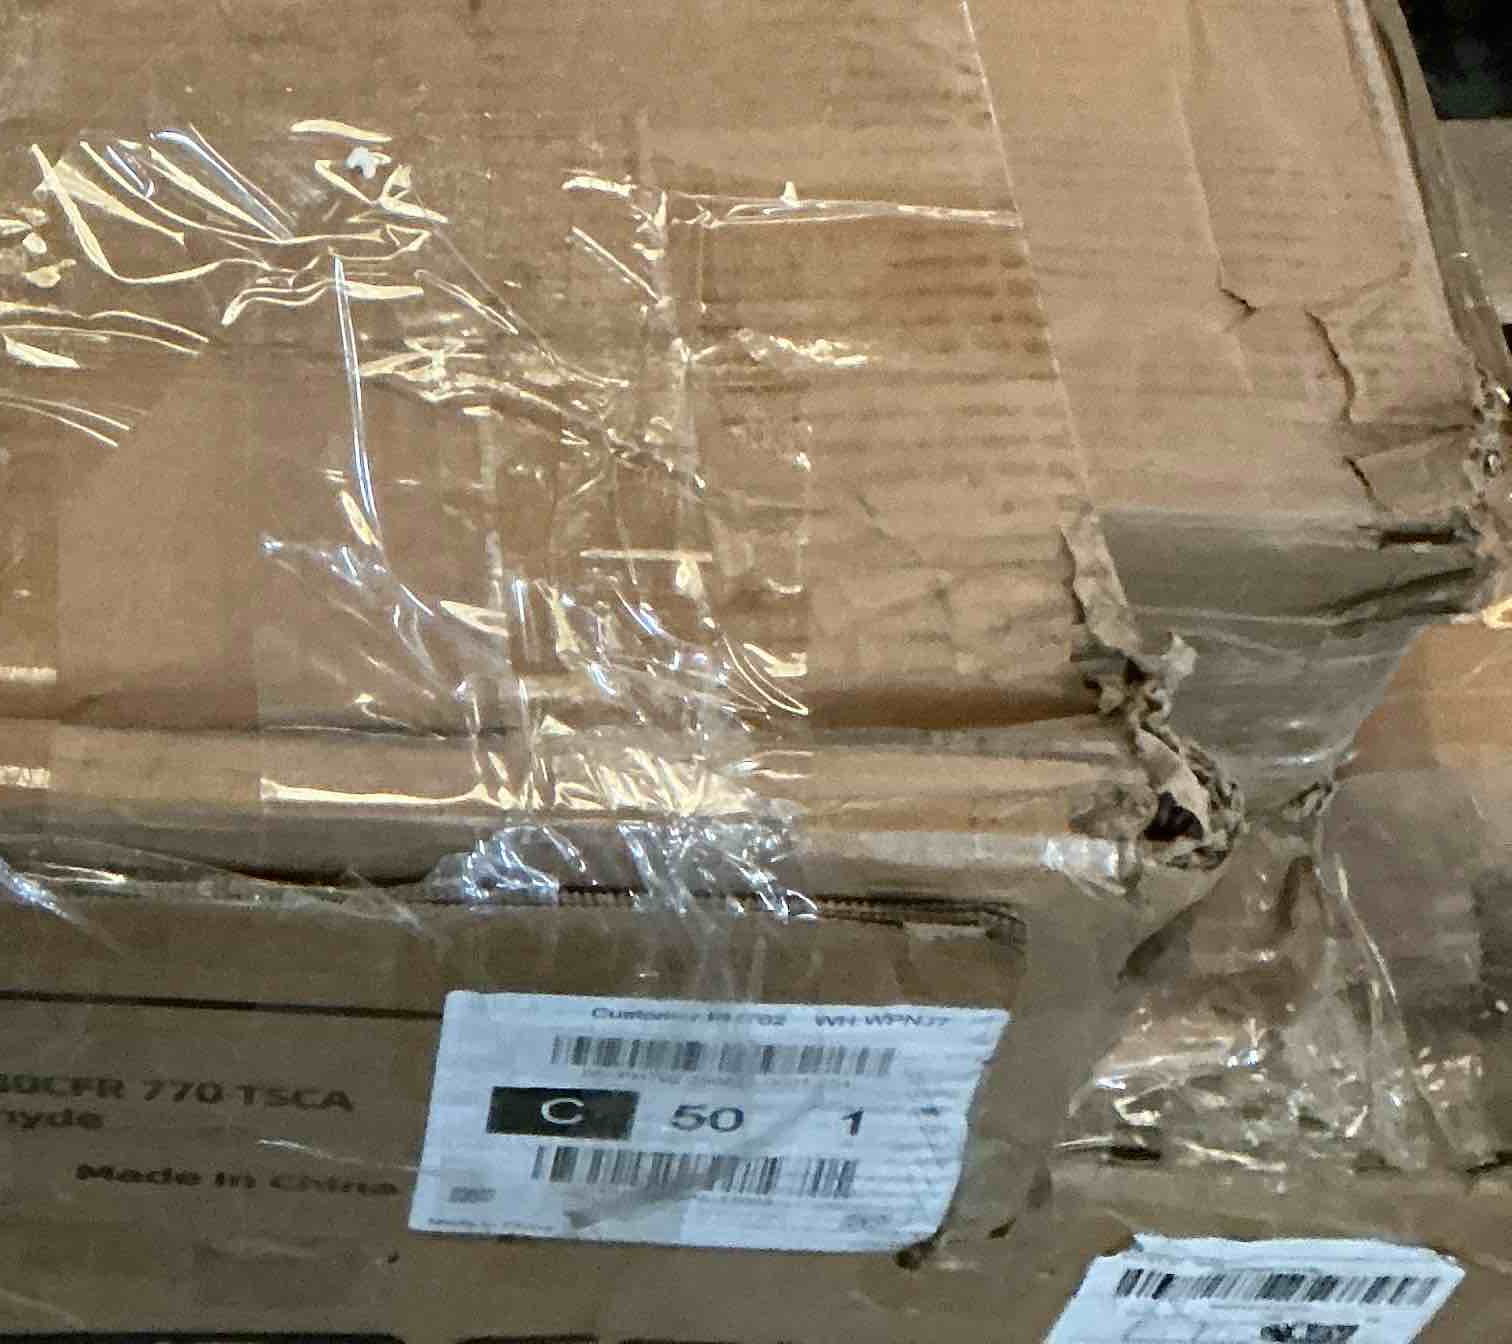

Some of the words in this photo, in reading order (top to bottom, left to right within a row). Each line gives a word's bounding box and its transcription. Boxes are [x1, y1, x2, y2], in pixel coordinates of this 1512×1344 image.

[142, 1077, 222, 1106] 770
[230, 1081, 355, 1113] TSCA
[539, 1099, 586, 1124] C
[671, 1103, 745, 1133] 50
[840, 1107, 866, 1136] 1
[75, 1163, 201, 1188] Made
[270, 1171, 400, 1198] China
